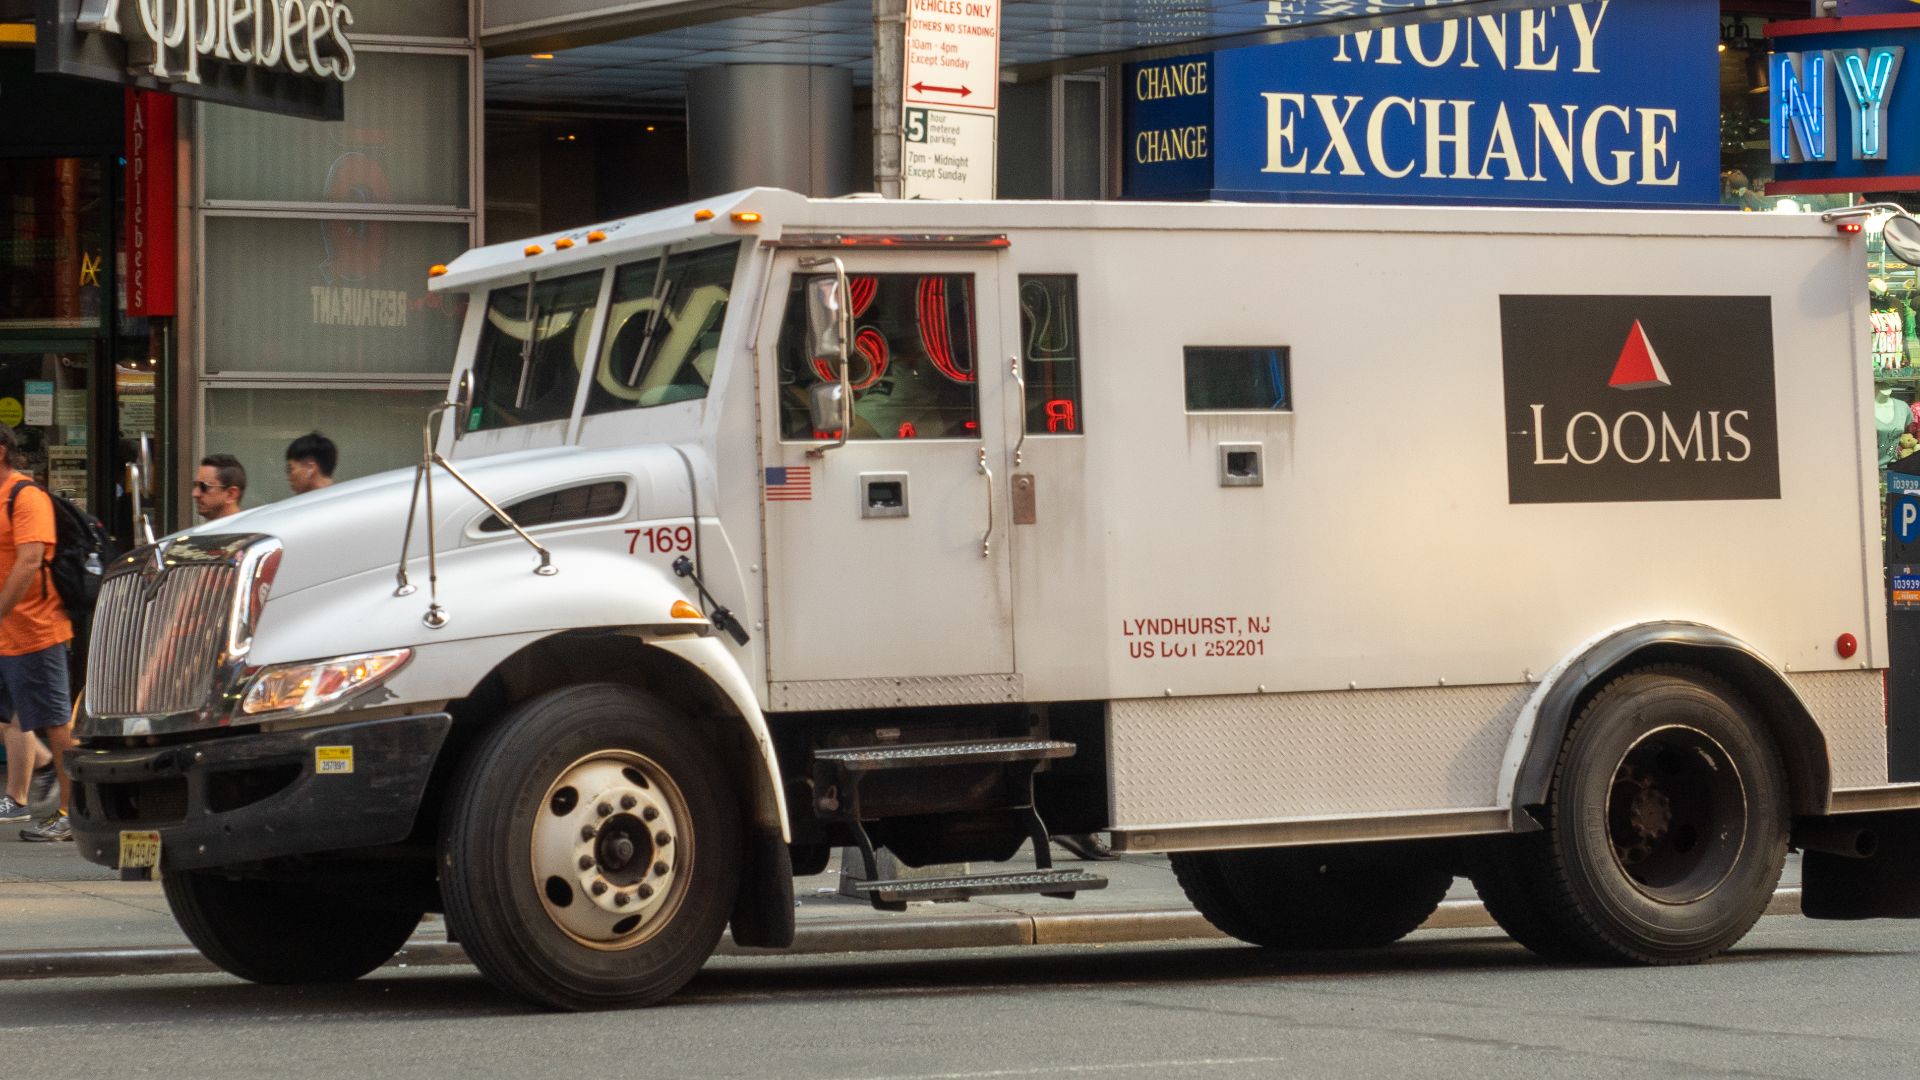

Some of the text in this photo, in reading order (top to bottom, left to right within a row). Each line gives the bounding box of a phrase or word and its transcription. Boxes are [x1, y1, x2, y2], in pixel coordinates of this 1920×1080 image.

[913, 0, 992, 18] VEHICLES ONLY
[912, 21, 995, 38] OTHERS NO STANDING
[911, 40, 932, 51] 10am
[940, 42, 958, 54] 4pm
[911, 53, 970, 71] Except Sunday
[1136, 62, 1207, 101] CHANGE
[1769, 46, 1906, 164] NY
[908, 111, 924, 142] 5
[930, 114, 946, 123] hour
[930, 124, 960, 135] metered
[1260, 91, 1680, 187] EXCHANGE
[930, 136, 956, 147] parking
[1136, 126, 1207, 164] CHANGE
[909, 152, 926, 164] 7pm
[934, 154, 969, 169] Midnight
[908, 167, 967, 183] Except Sunday
[1529, 404, 1751, 465] LOOMIS
[1902, 503, 1917, 536] P
[624, 526, 692, 554] 7169
[1123, 616, 1270, 636] LYNDHURST, NJ
[1129, 641, 1155, 659] US
[1205, 639, 1264, 657] 252201
